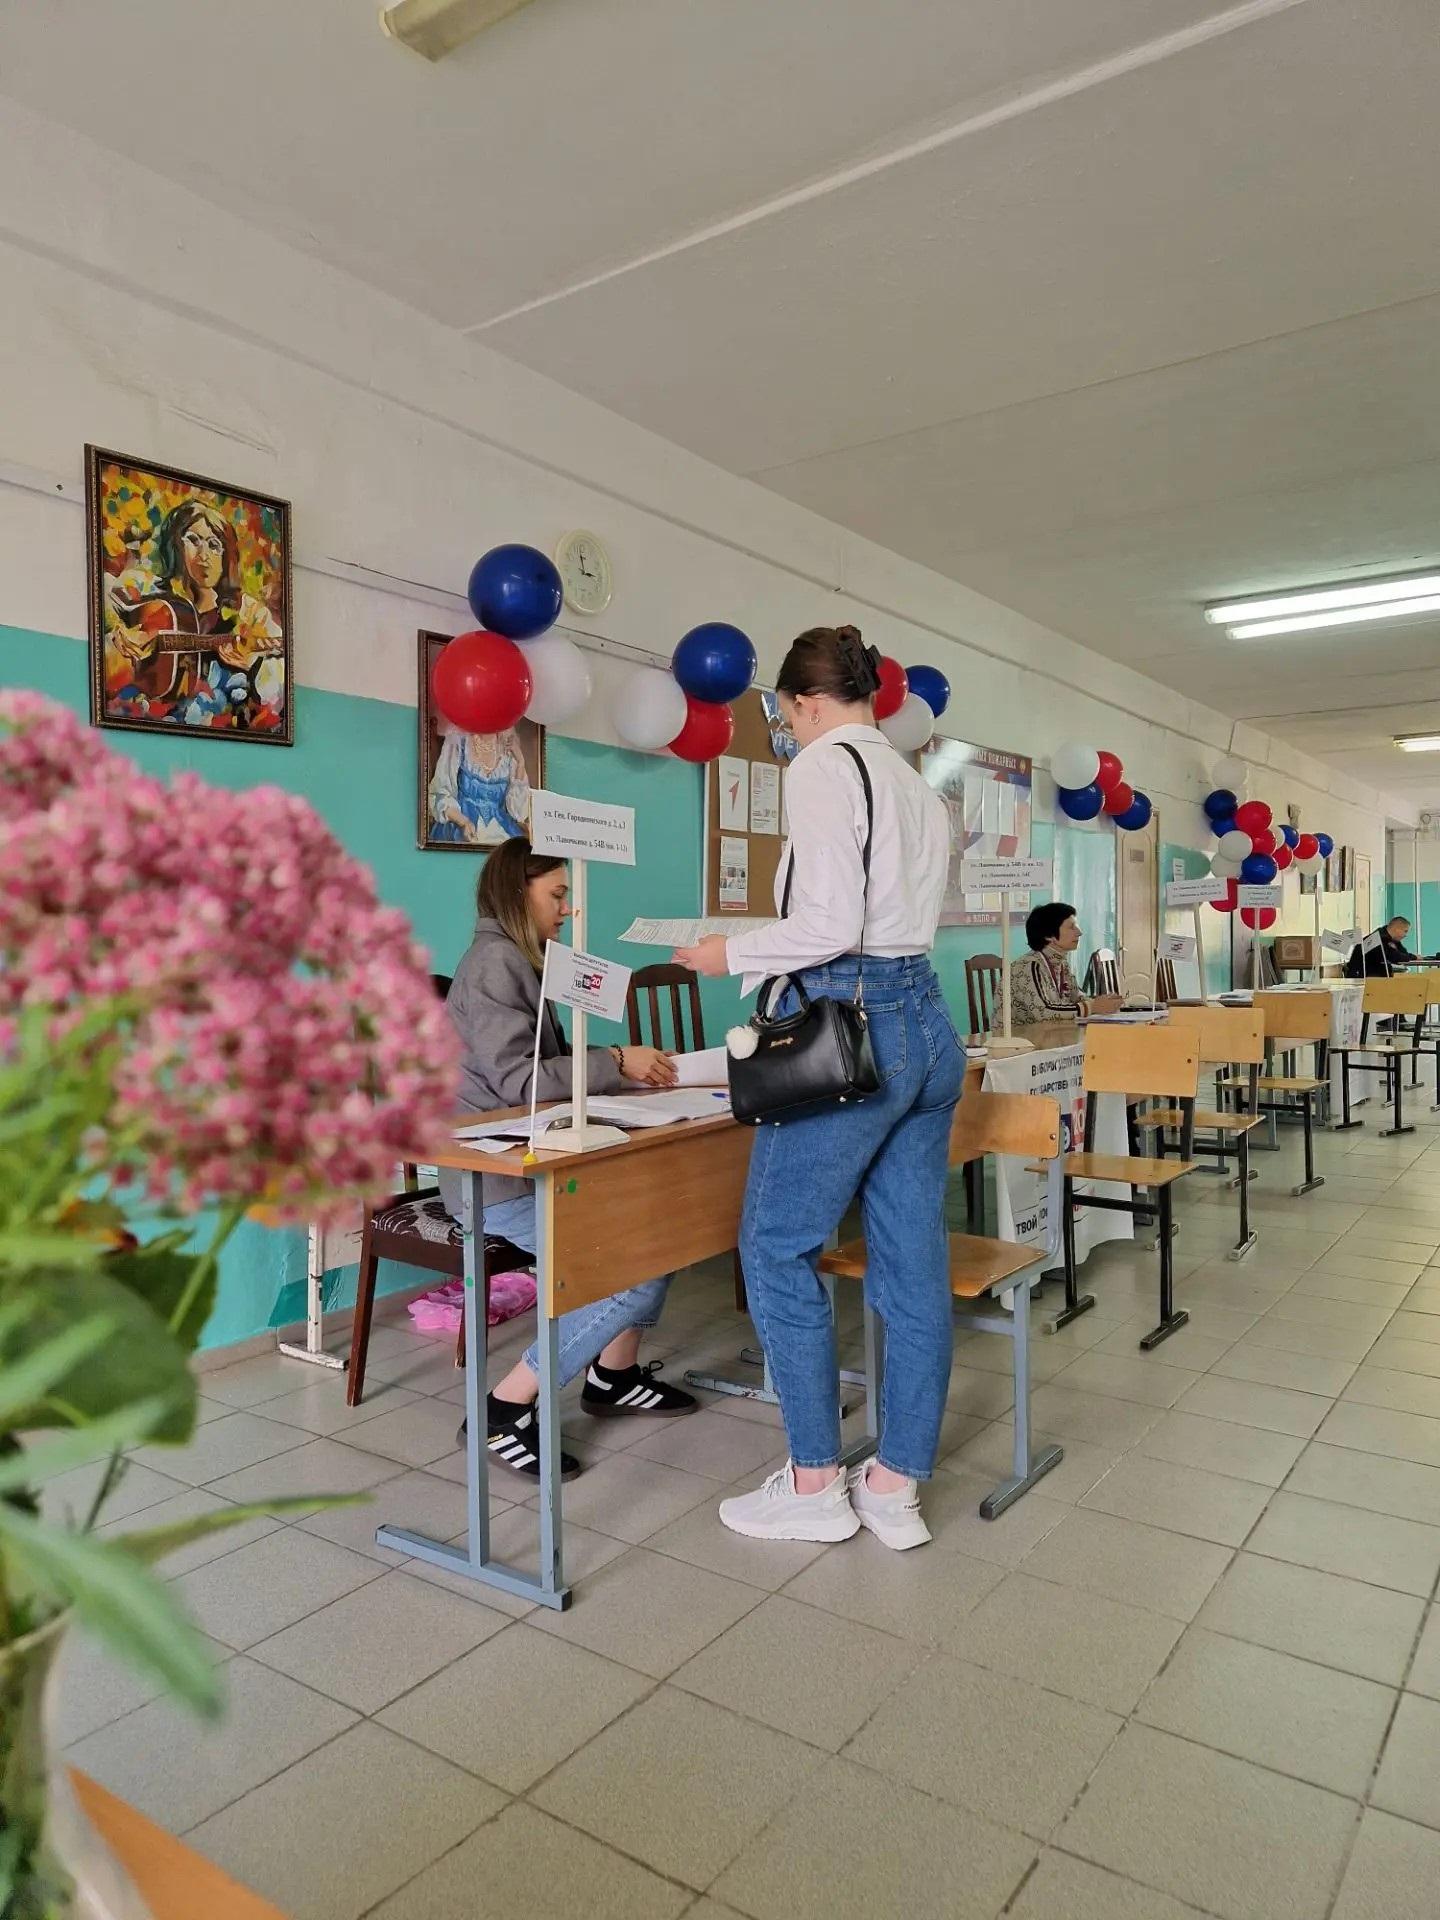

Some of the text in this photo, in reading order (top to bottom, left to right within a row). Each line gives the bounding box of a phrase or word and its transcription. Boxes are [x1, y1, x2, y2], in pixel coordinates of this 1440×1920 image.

[545, 835, 555, 843] ул.
[591, 975, 601, 986] 20
[1016, 1214, 1038, 1236] ТВОЙ
